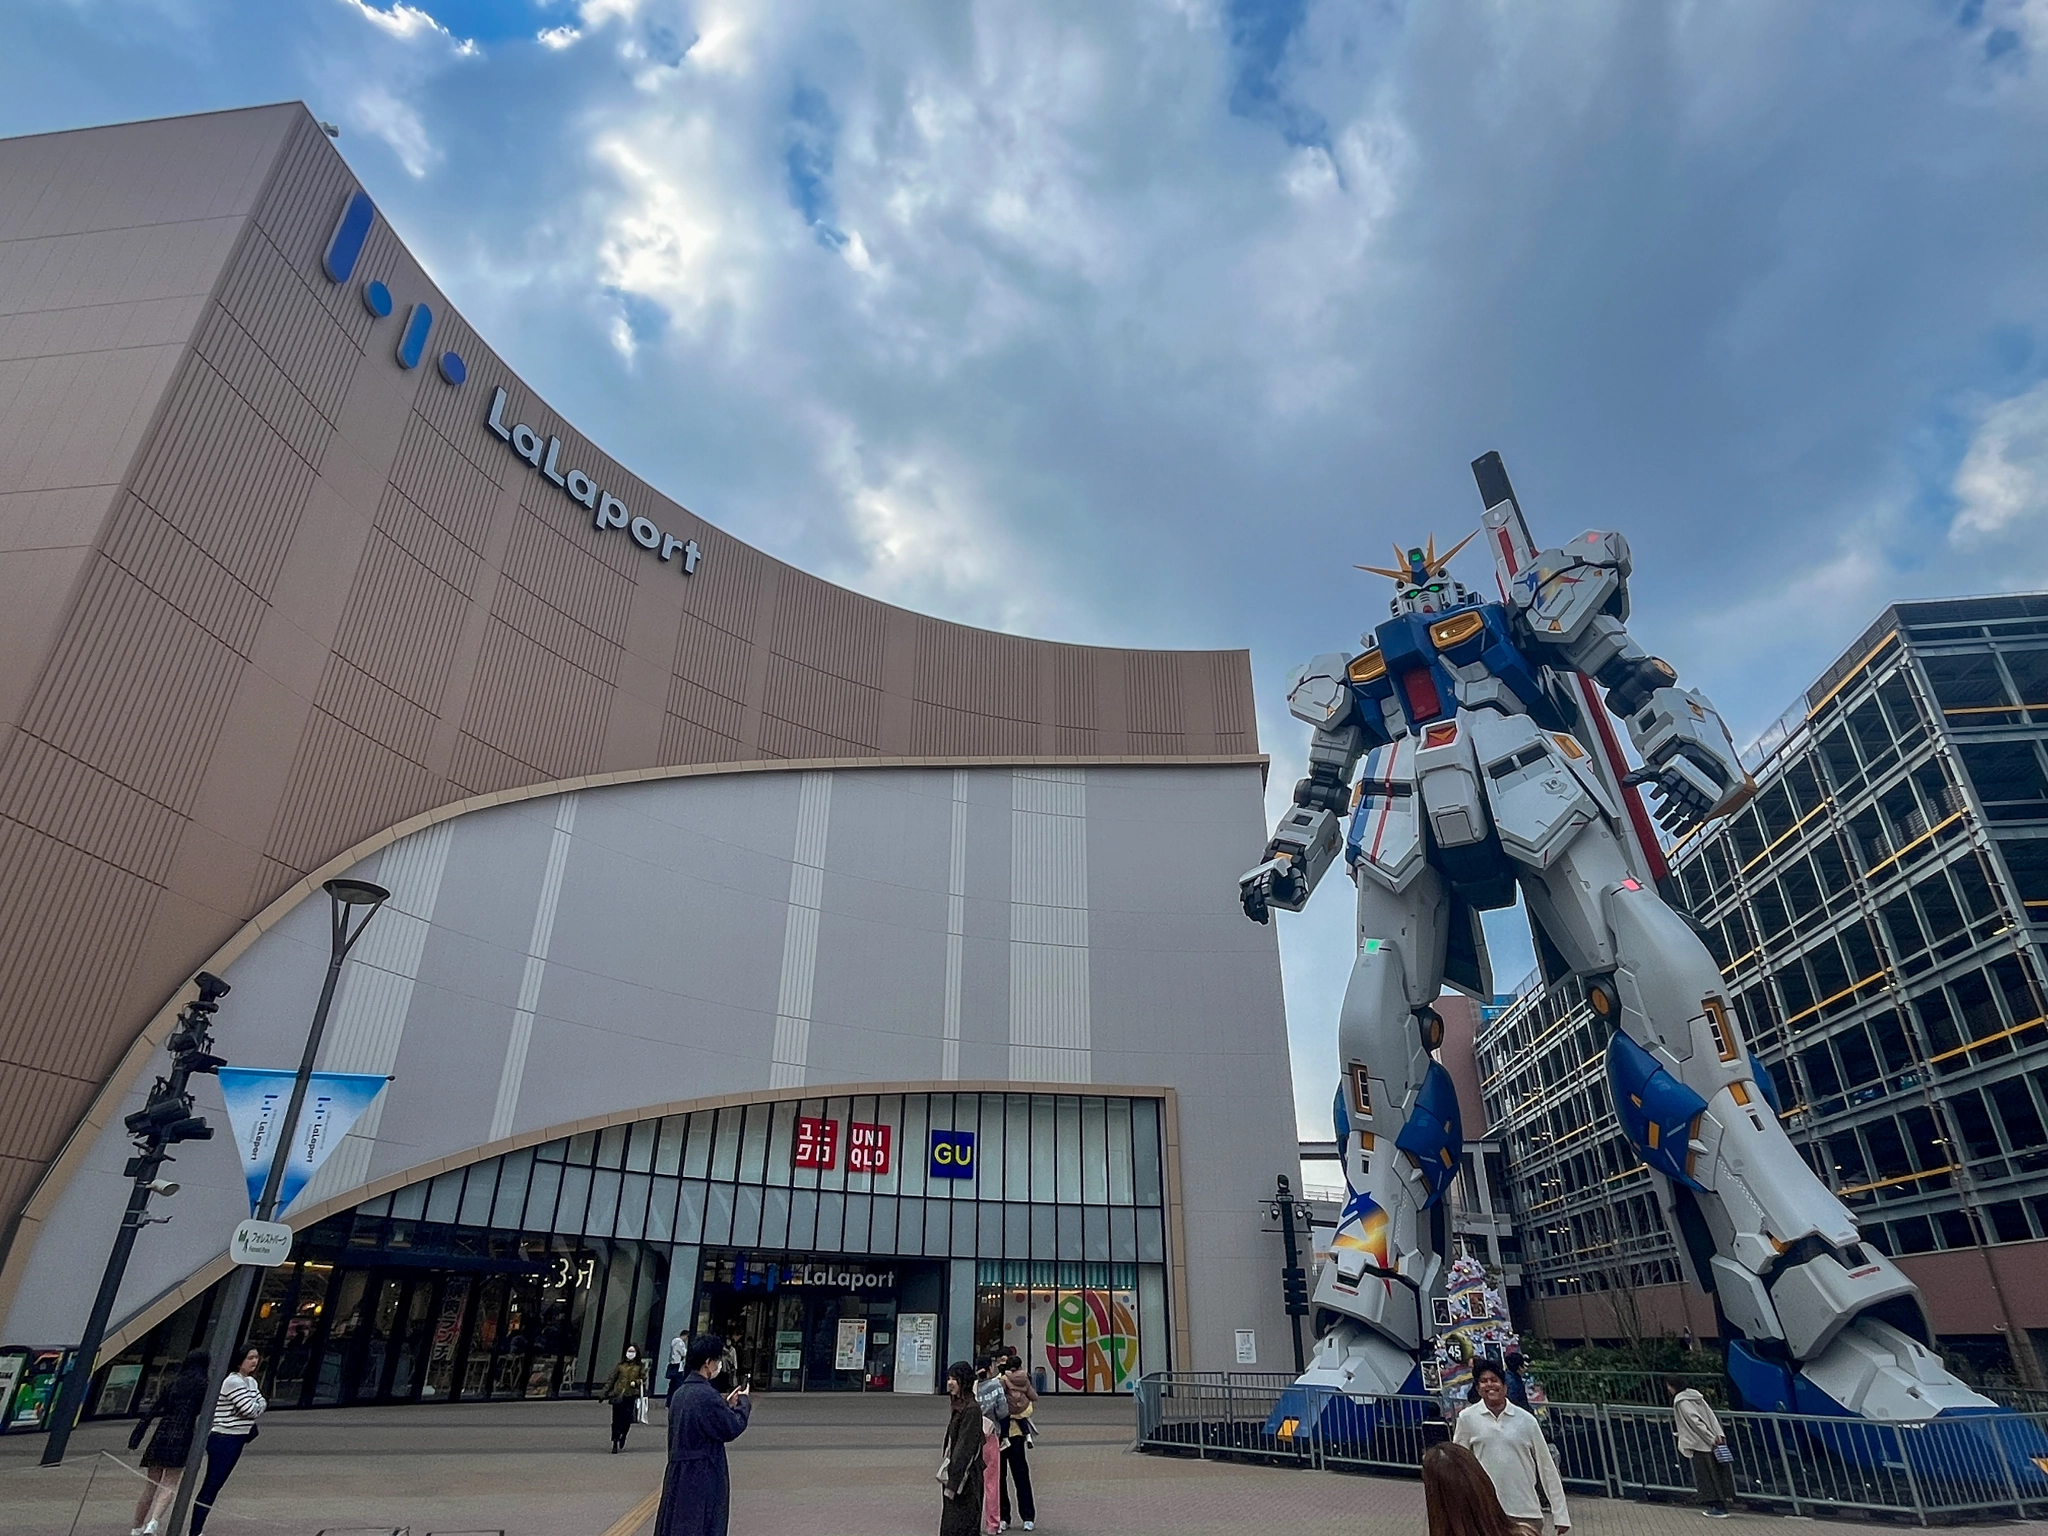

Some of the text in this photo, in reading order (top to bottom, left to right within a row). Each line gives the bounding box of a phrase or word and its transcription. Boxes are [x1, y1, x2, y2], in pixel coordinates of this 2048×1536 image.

[484, 386, 703, 575] LaLaport
[250, 1121, 268, 1161] LaLaport
[306, 1124, 323, 1163] LaLaport
[934, 1142, 971, 1166] GU
[804, 1265, 895, 1291] LaLaport
[1448, 1344, 1462, 1358] 45
